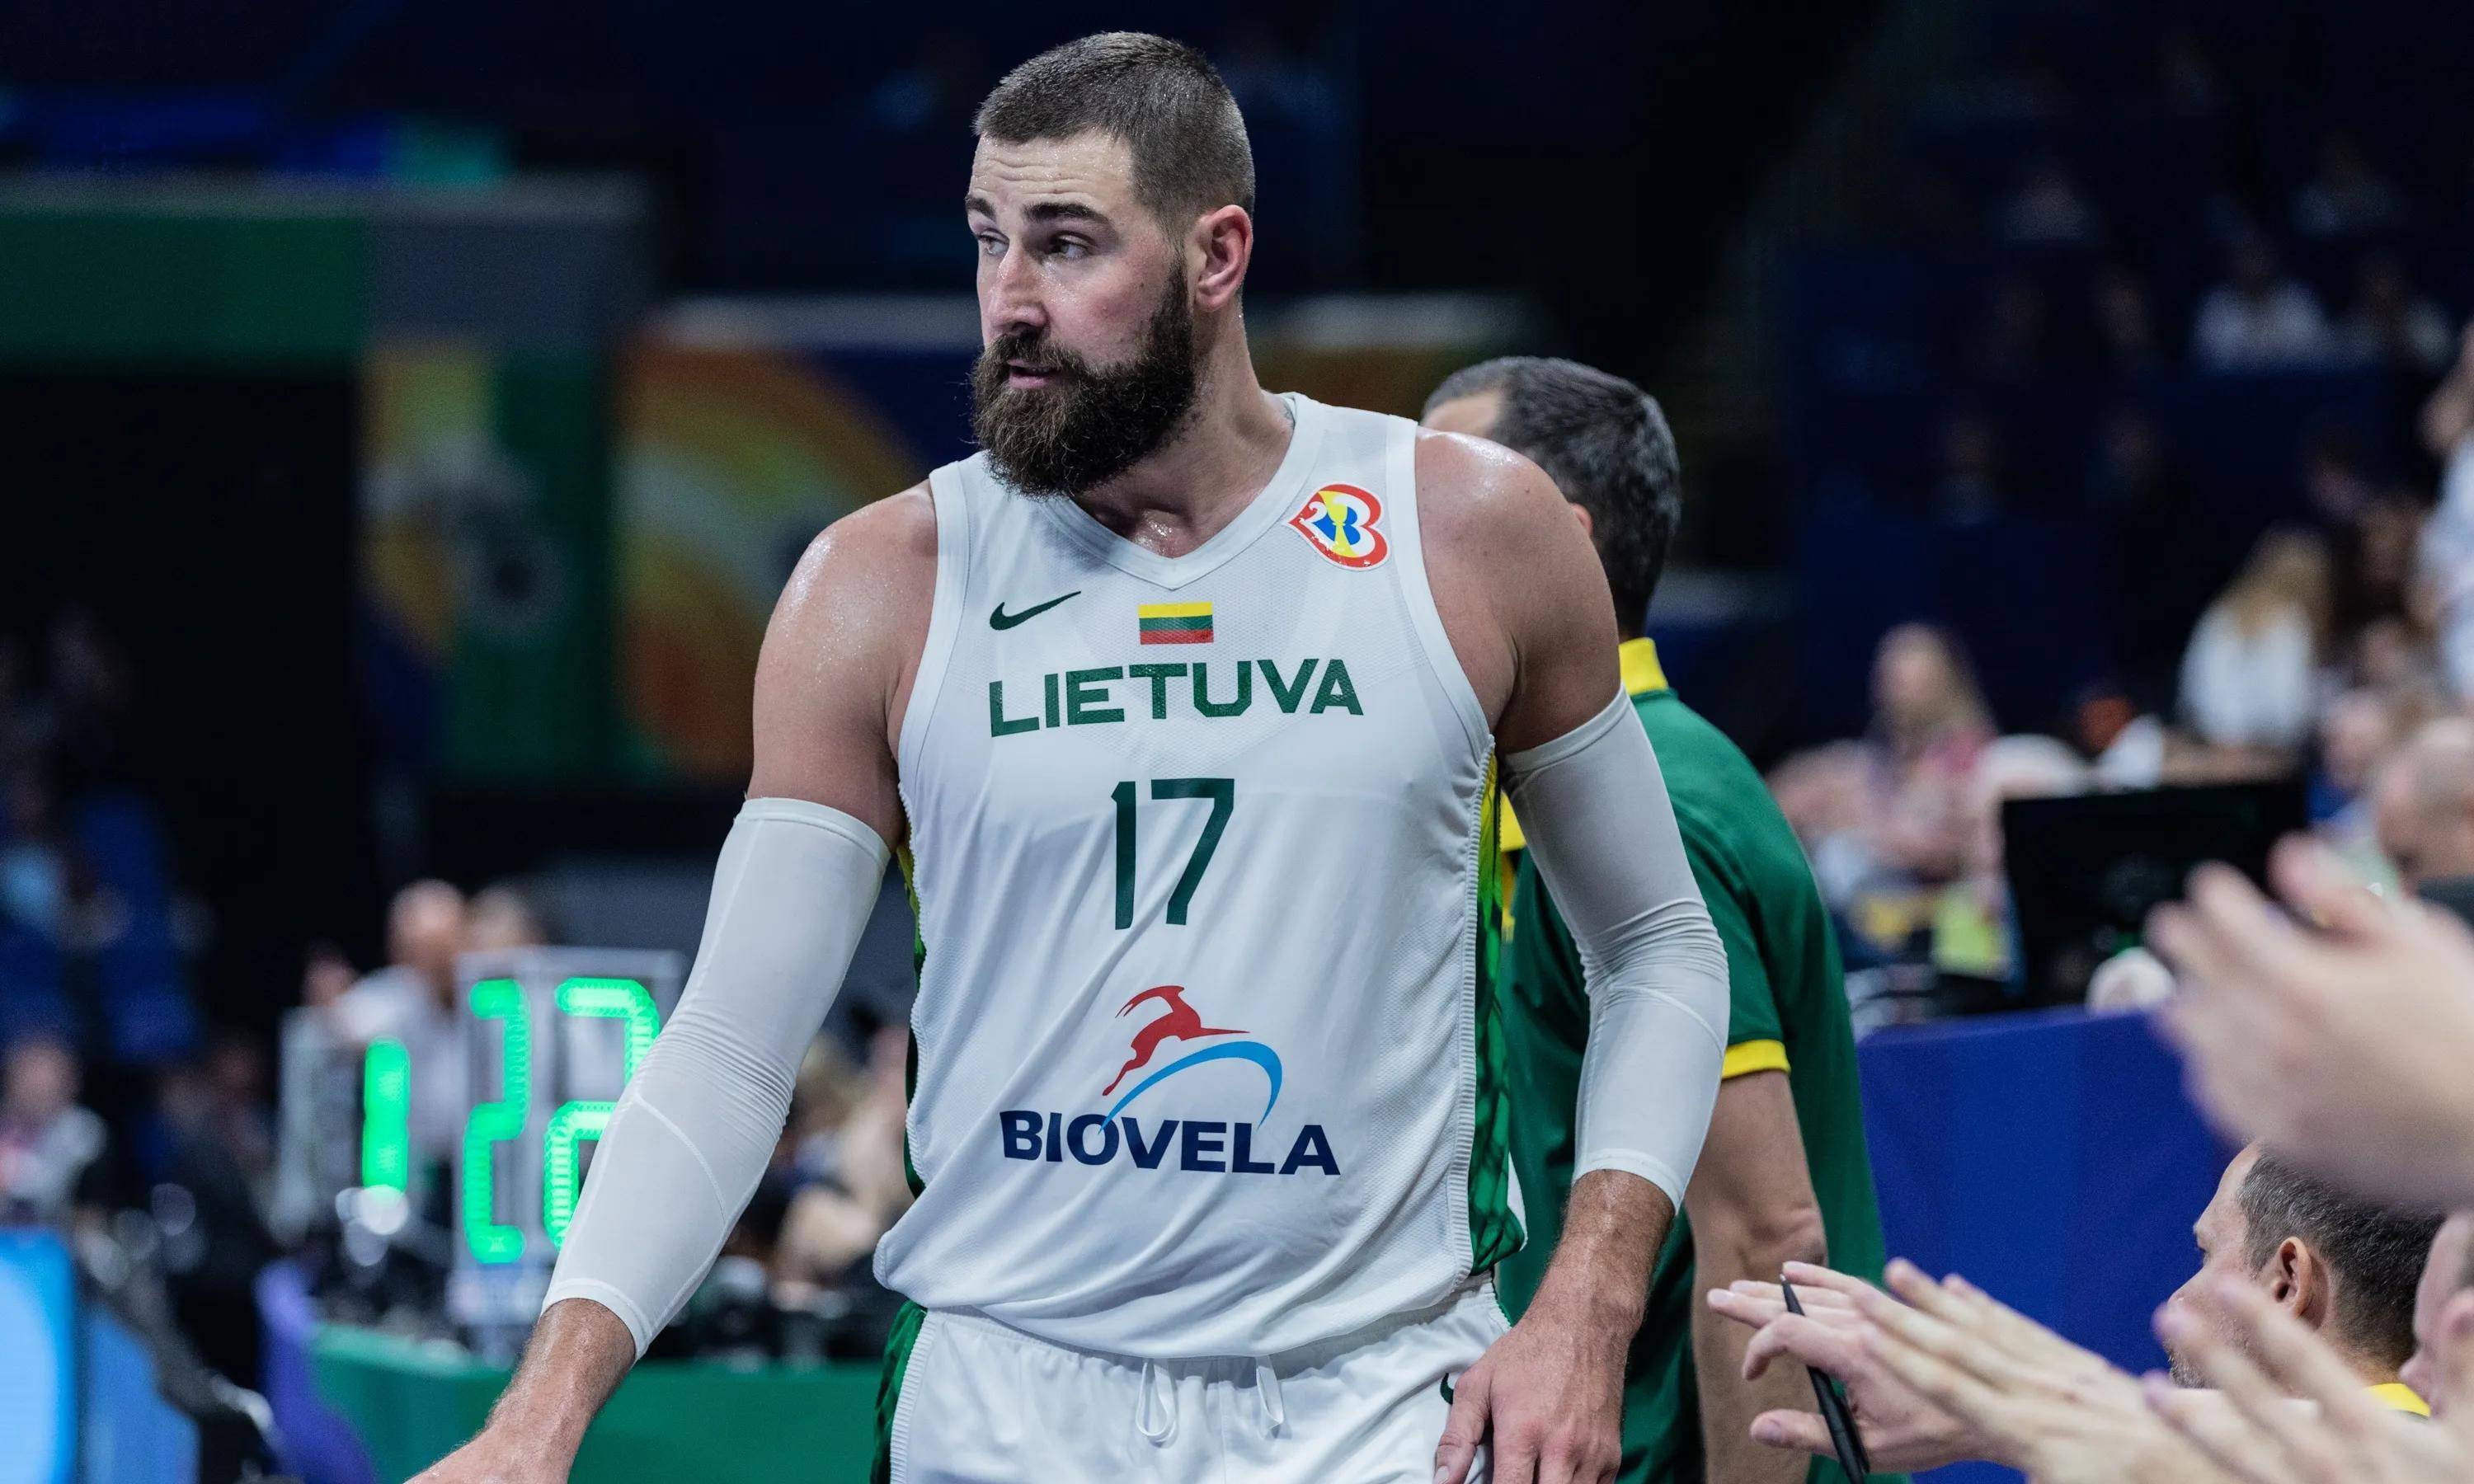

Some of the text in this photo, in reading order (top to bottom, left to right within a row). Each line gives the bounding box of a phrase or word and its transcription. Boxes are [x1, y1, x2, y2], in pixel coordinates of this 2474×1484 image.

[989, 658, 1363, 737] LIETUVA
[1111, 777, 1235, 930] 17
[999, 1110, 1341, 1176] BIOVELA
